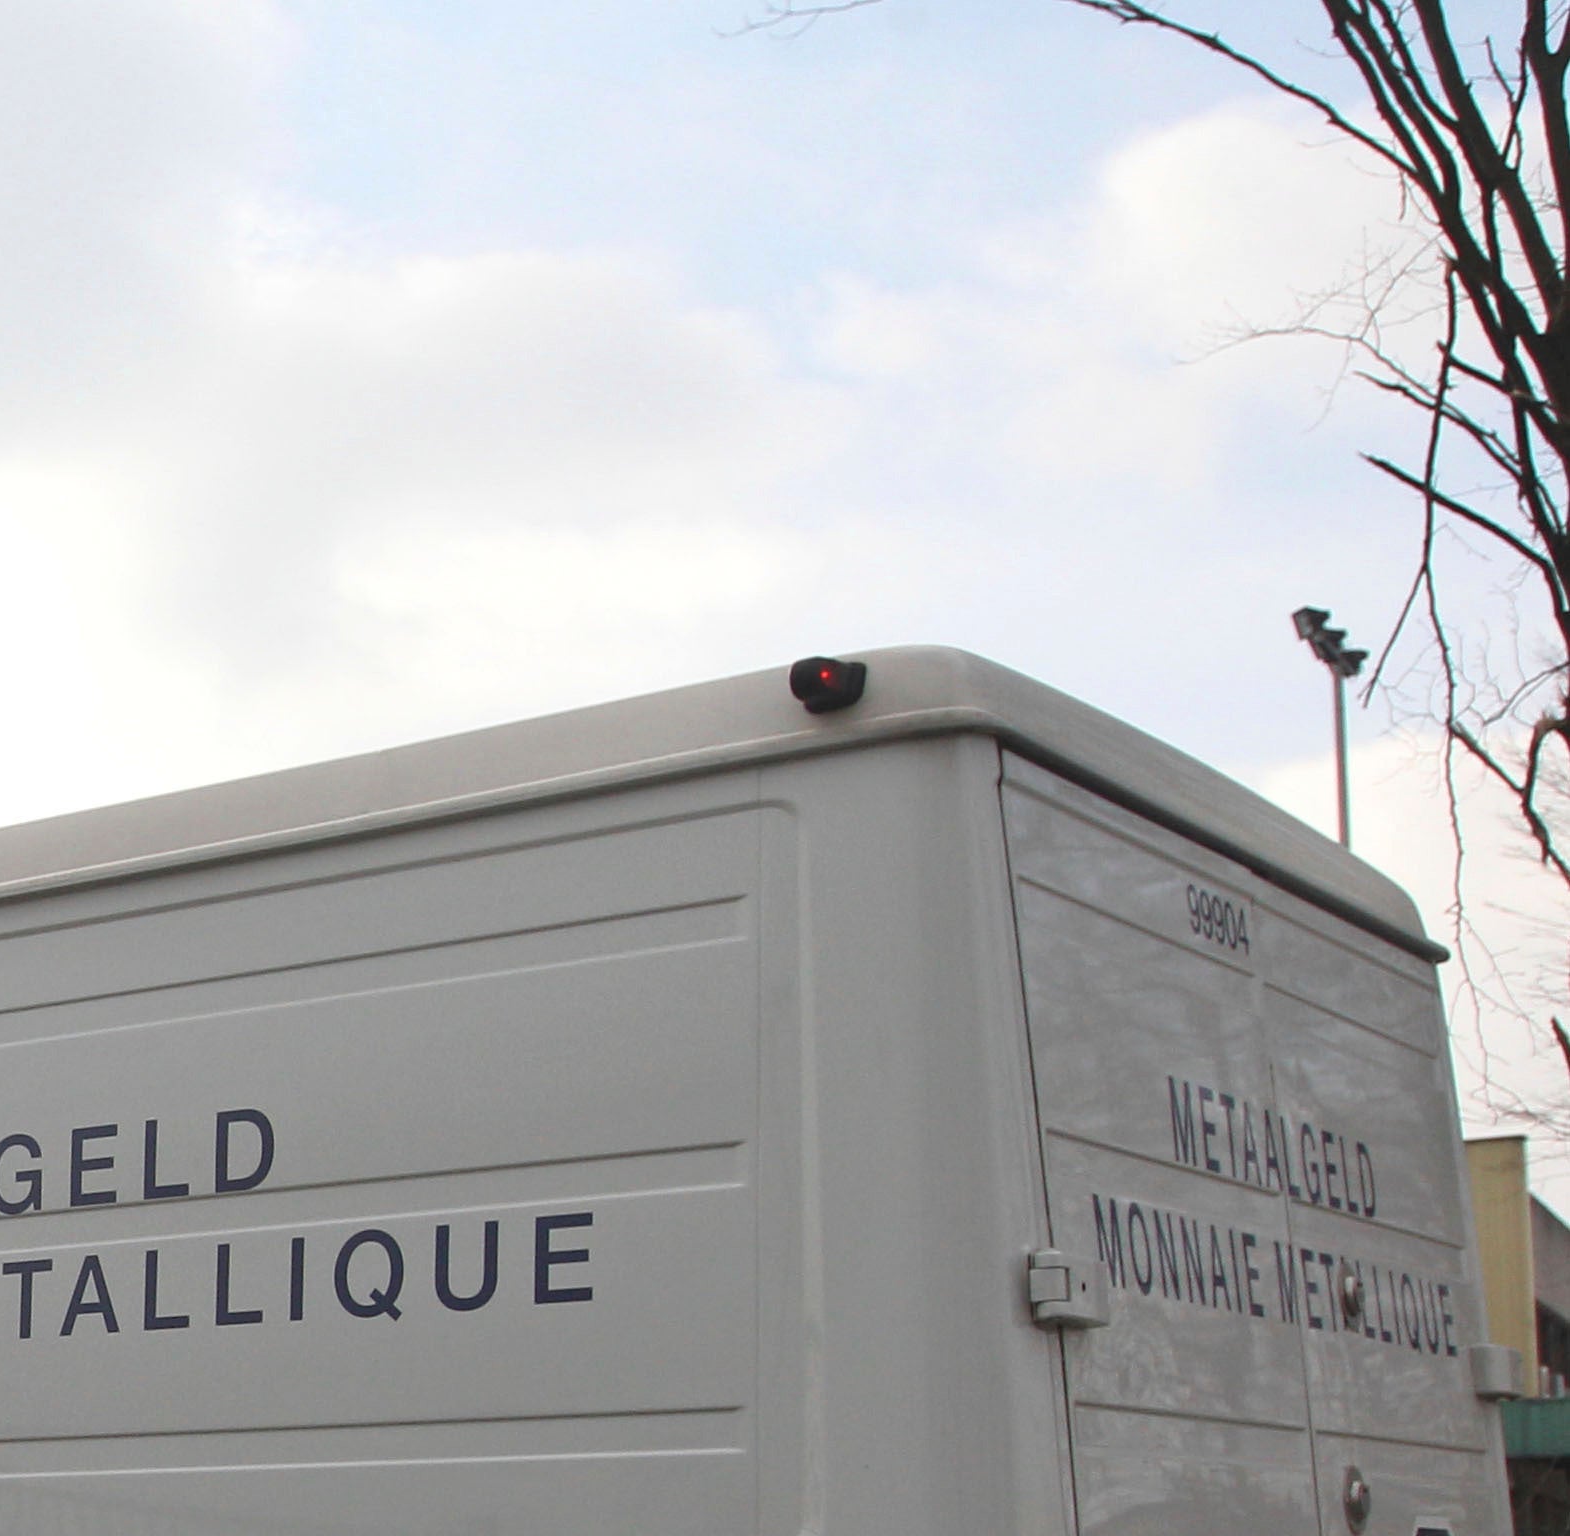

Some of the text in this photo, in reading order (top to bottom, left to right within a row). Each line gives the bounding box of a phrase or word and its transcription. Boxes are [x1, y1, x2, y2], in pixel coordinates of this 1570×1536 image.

[1187, 884, 1250, 956] 99904
[1167, 1075, 1376, 1218] METAALGELD
[1092, 1193, 1264, 1317] MONNAIE
